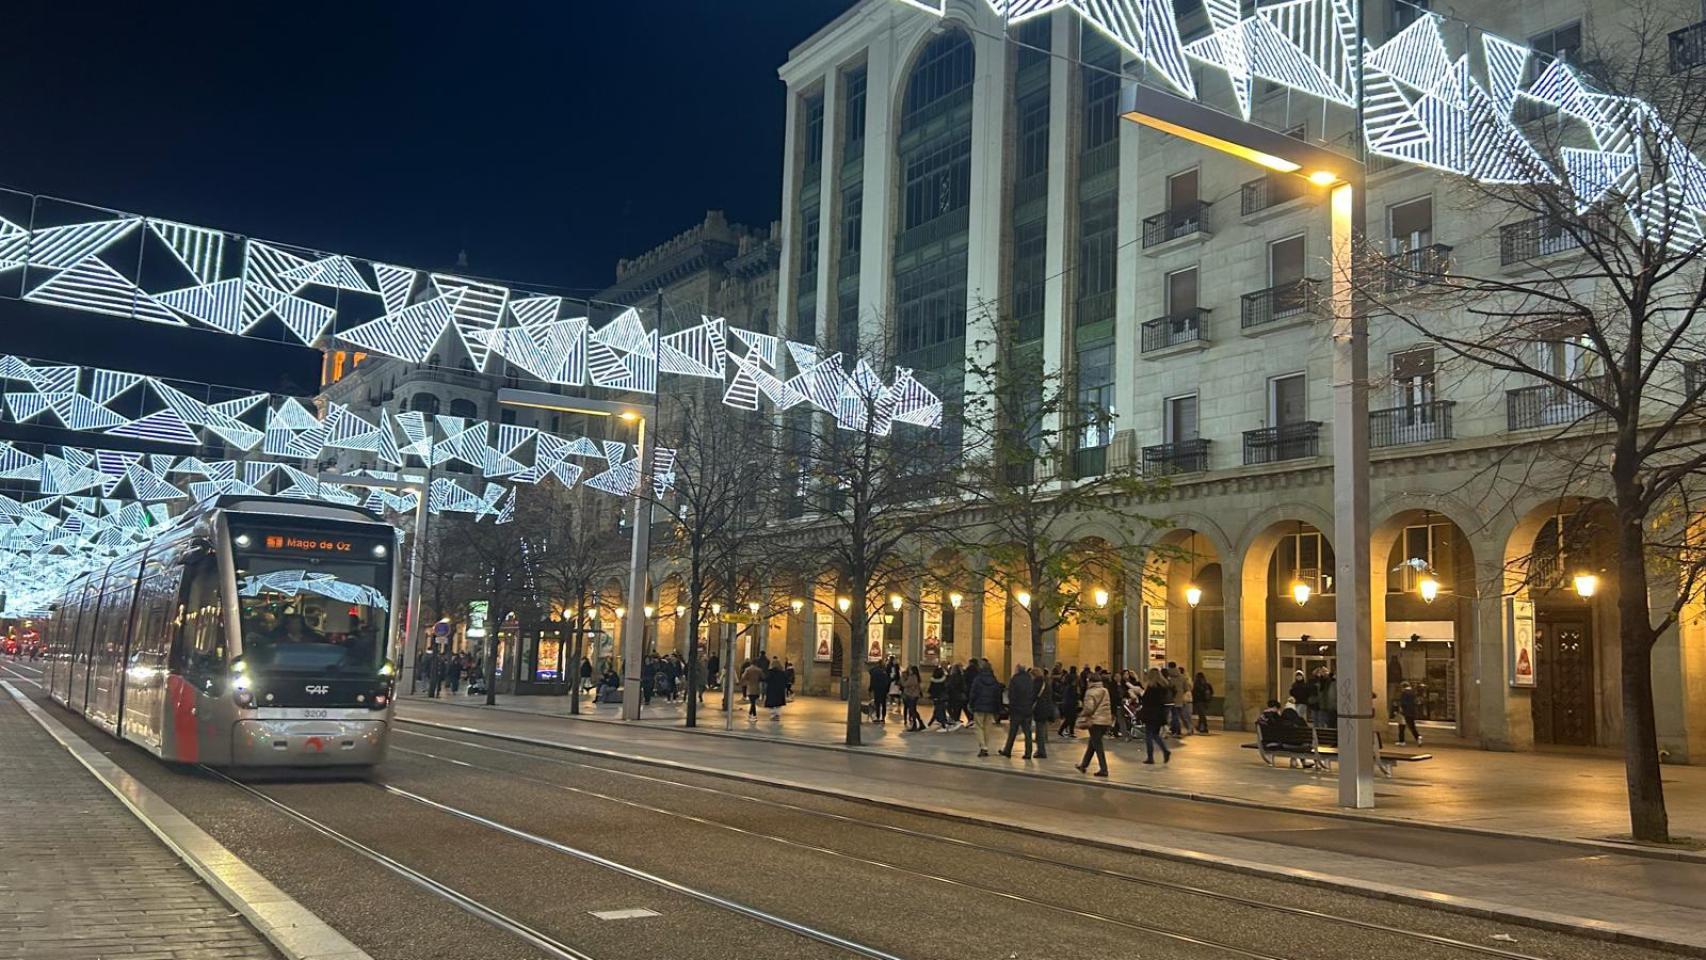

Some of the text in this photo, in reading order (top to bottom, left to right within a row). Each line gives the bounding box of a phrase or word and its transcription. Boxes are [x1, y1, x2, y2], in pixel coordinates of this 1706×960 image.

[287, 538, 317, 550] Mago
[320, 541, 333, 549] de
[336, 541, 351, 551] Oz
[305, 685, 329, 695] CAF
